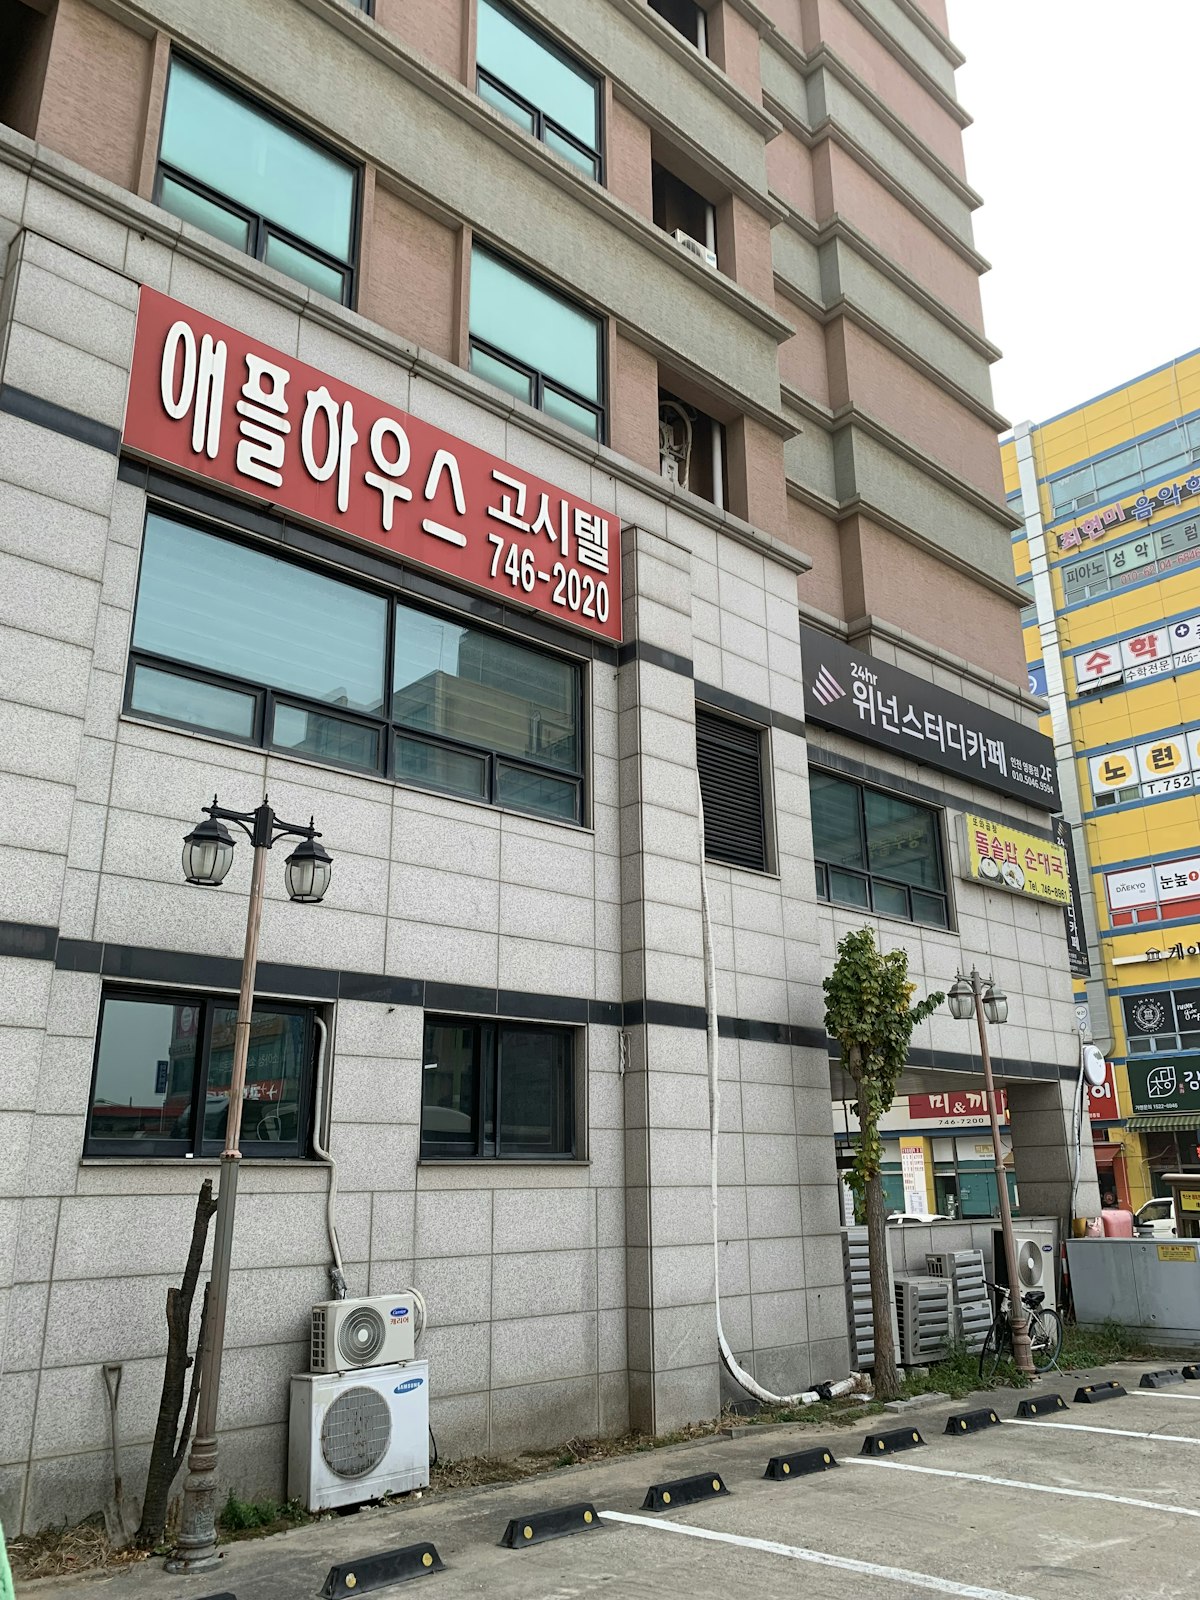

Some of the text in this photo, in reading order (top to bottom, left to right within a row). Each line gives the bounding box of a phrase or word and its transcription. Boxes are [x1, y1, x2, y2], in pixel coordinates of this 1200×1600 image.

[161, 320, 611, 575] 애플하우스 고시텔
[488, 532, 610, 624] 746-2020
[1066, 561, 1105, 583] 피아노
[850, 661, 878, 687] 24hr
[1126, 660, 1170, 681] 수학전문
[851, 679, 1008, 778] 위넌스터디카페
[1039, 764, 1052, 782] 2F
[975, 830, 1064, 880] 돌솥밥 순대국
[1115, 882, 1146, 893] DAEKYO
[938, 1117, 985, 1126] 746-7200
